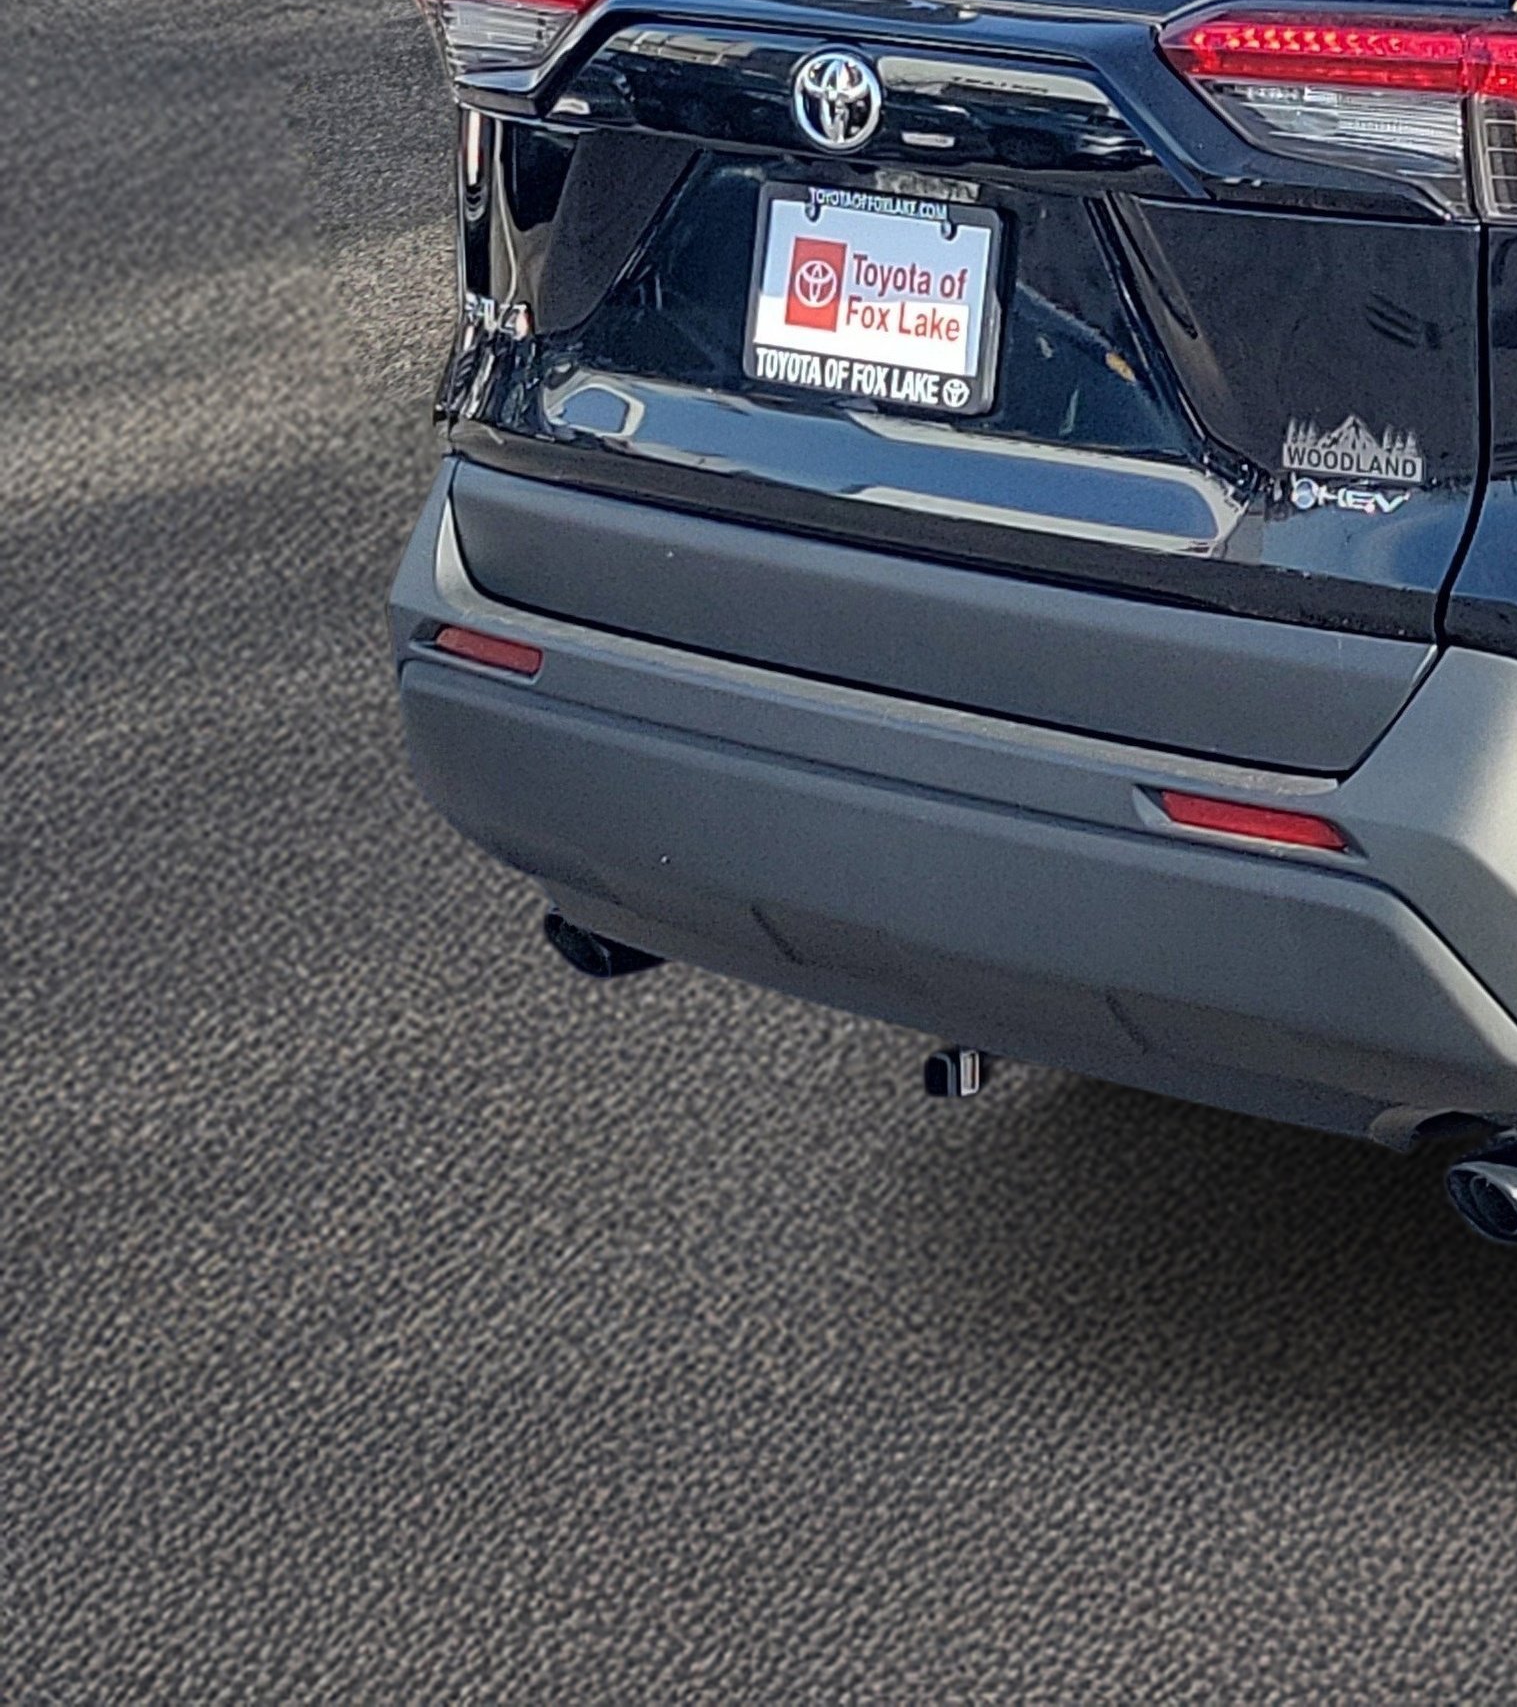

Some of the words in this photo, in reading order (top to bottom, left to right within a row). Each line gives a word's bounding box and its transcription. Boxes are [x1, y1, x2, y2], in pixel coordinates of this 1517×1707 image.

[853, 253, 931, 297] Toyota
[940, 268, 968, 300] of
[846, 296, 889, 332] Fox
[898, 302, 960, 341] Lake
[756, 347, 821, 386] TOYOTA
[824, 358, 849, 389] OF
[852, 361, 890, 395] FOX
[891, 368, 939, 404] LAKE
[1287, 446, 1417, 478] WOODLAND
